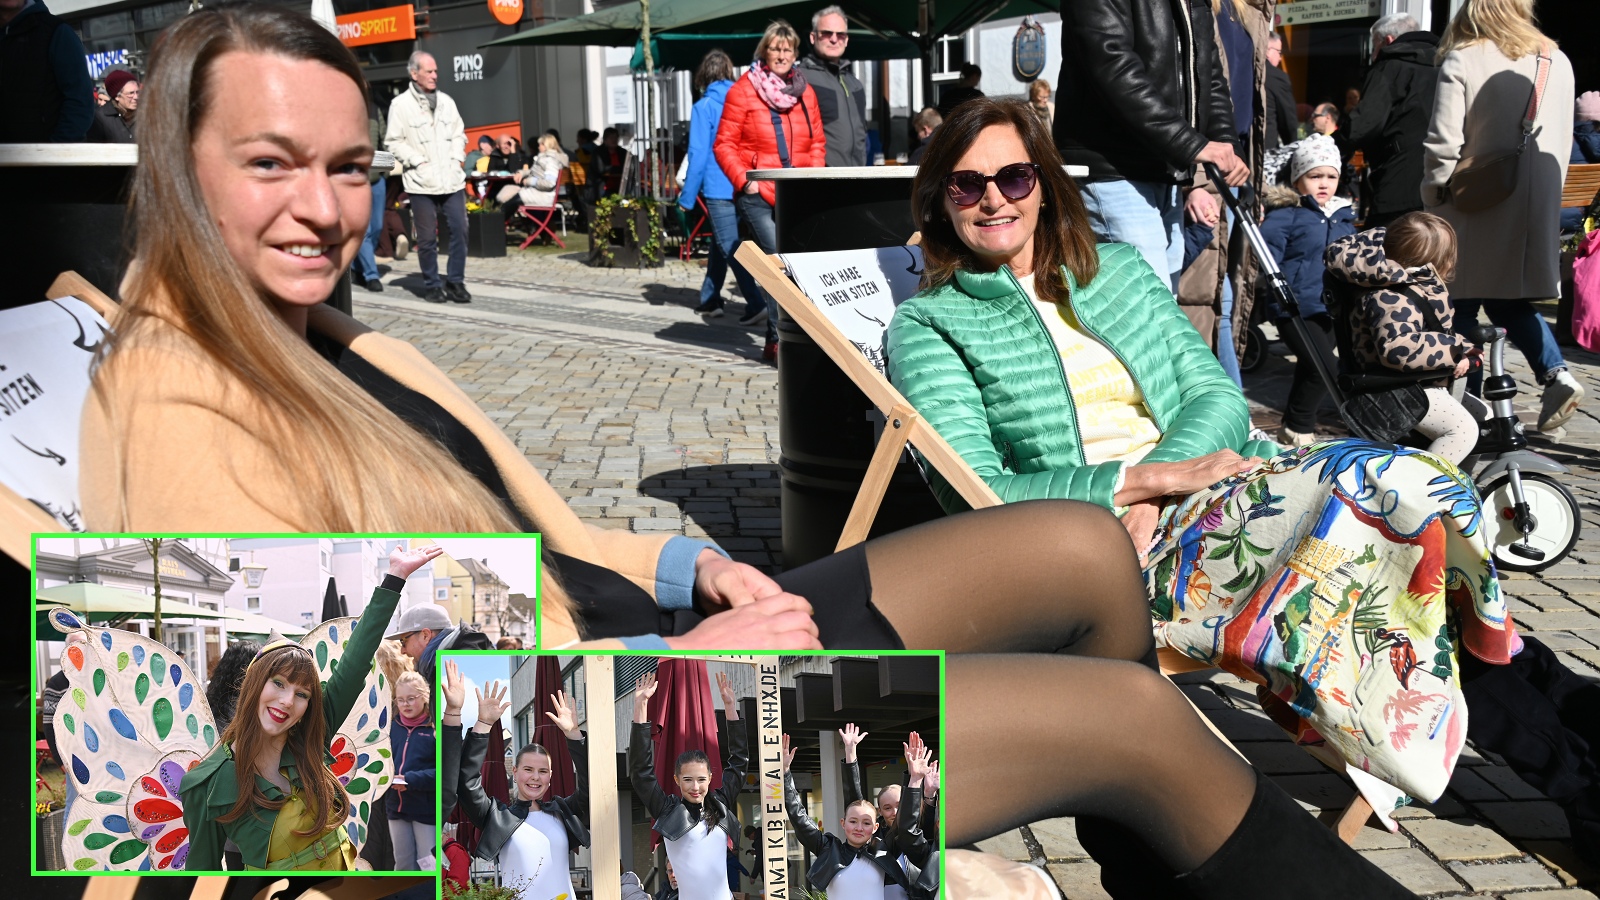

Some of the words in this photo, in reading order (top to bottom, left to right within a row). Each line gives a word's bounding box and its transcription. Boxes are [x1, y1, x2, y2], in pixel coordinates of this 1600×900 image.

[1333, 8, 1356, 16] KUCHEN
[453, 53, 483, 73] PINO
[454, 70, 483, 82] SPRITZ
[819, 272, 839, 288] ICH
[836, 266, 862, 283] HABE
[822, 289, 851, 306] EINEN
[849, 280, 880, 299] SITZEN
